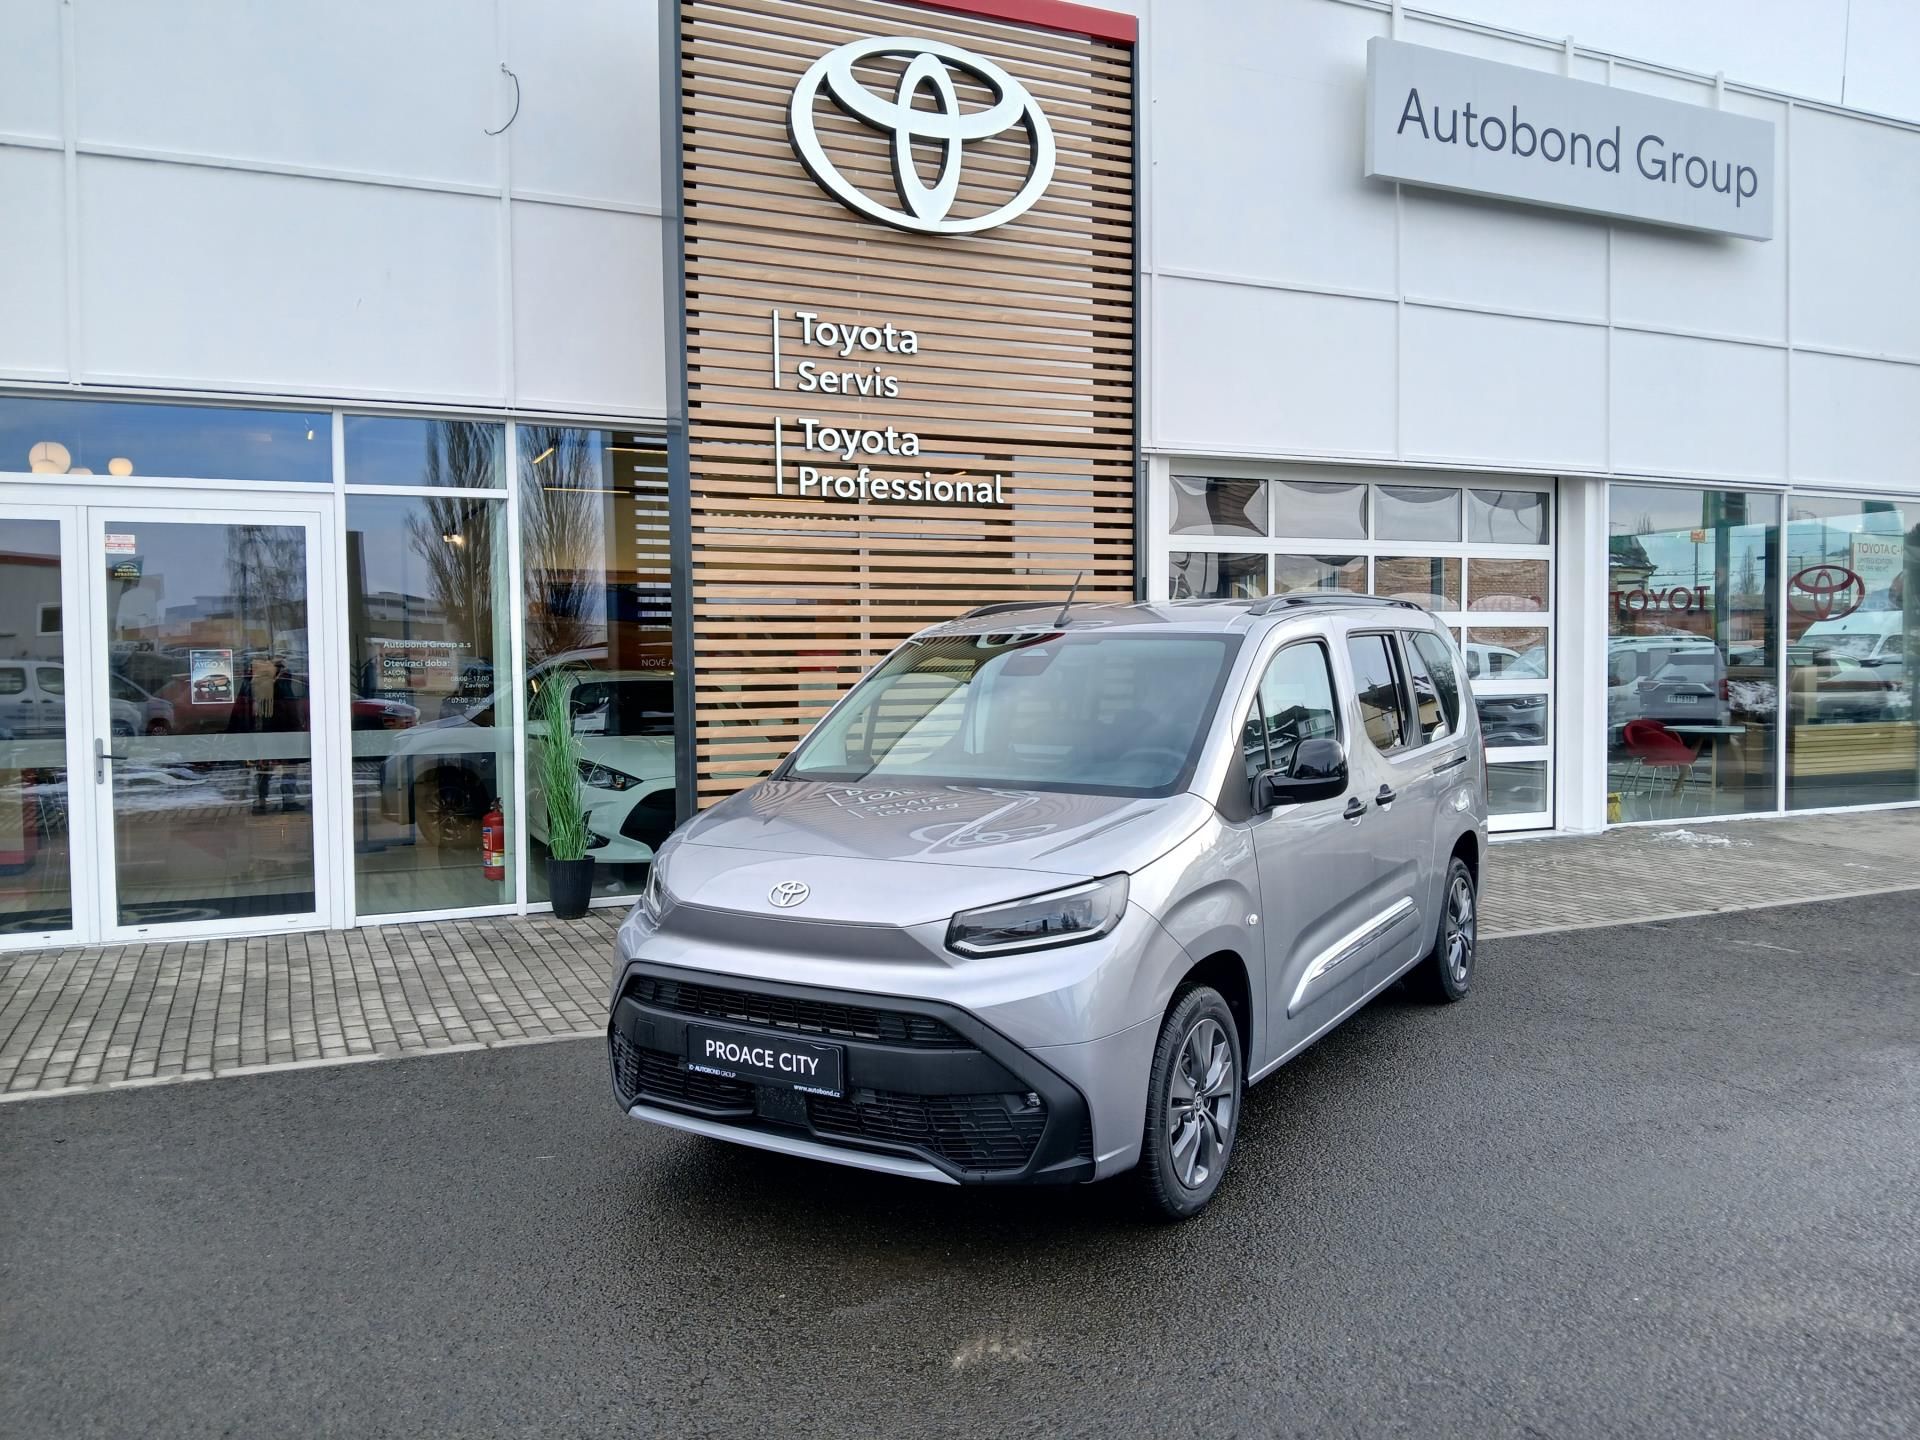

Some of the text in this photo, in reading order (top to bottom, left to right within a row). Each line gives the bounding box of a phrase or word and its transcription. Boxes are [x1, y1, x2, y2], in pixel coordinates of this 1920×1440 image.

[1397, 87, 1758, 208] Autobond Group
[795, 311, 918, 357] Toyota
[798, 361, 899, 398] Servis
[797, 418, 920, 461] Toyota
[799, 466, 1004, 504] Professional
[1857, 542, 1890, 555] TOYOTA
[383, 640, 427, 649] Autobond
[429, 640, 457, 650] Group
[425, 659, 450, 668] doba:
[641, 657, 666, 667] NOVÉ
[705, 1039, 819, 1077] PROACE CITY
[793, 1083, 841, 1099] www.autobond.cz
